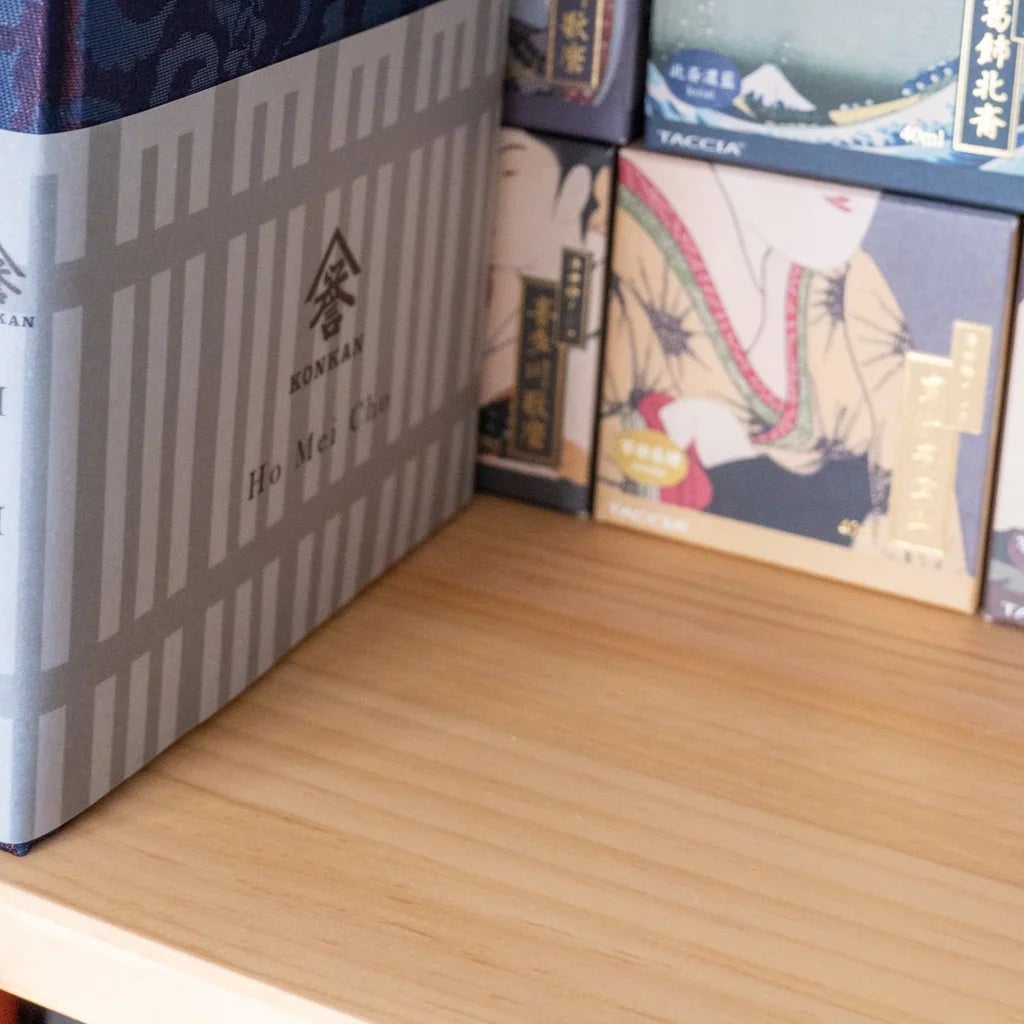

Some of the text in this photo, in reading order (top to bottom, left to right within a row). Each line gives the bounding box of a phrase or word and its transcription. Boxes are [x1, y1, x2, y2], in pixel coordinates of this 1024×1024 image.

[657, 128, 742, 156] TACCIA
[899, 124, 945, 148] 40ml
[289, 334, 364, 395] KONKAN
[247, 391, 392, 501] Ho Mei Cho
